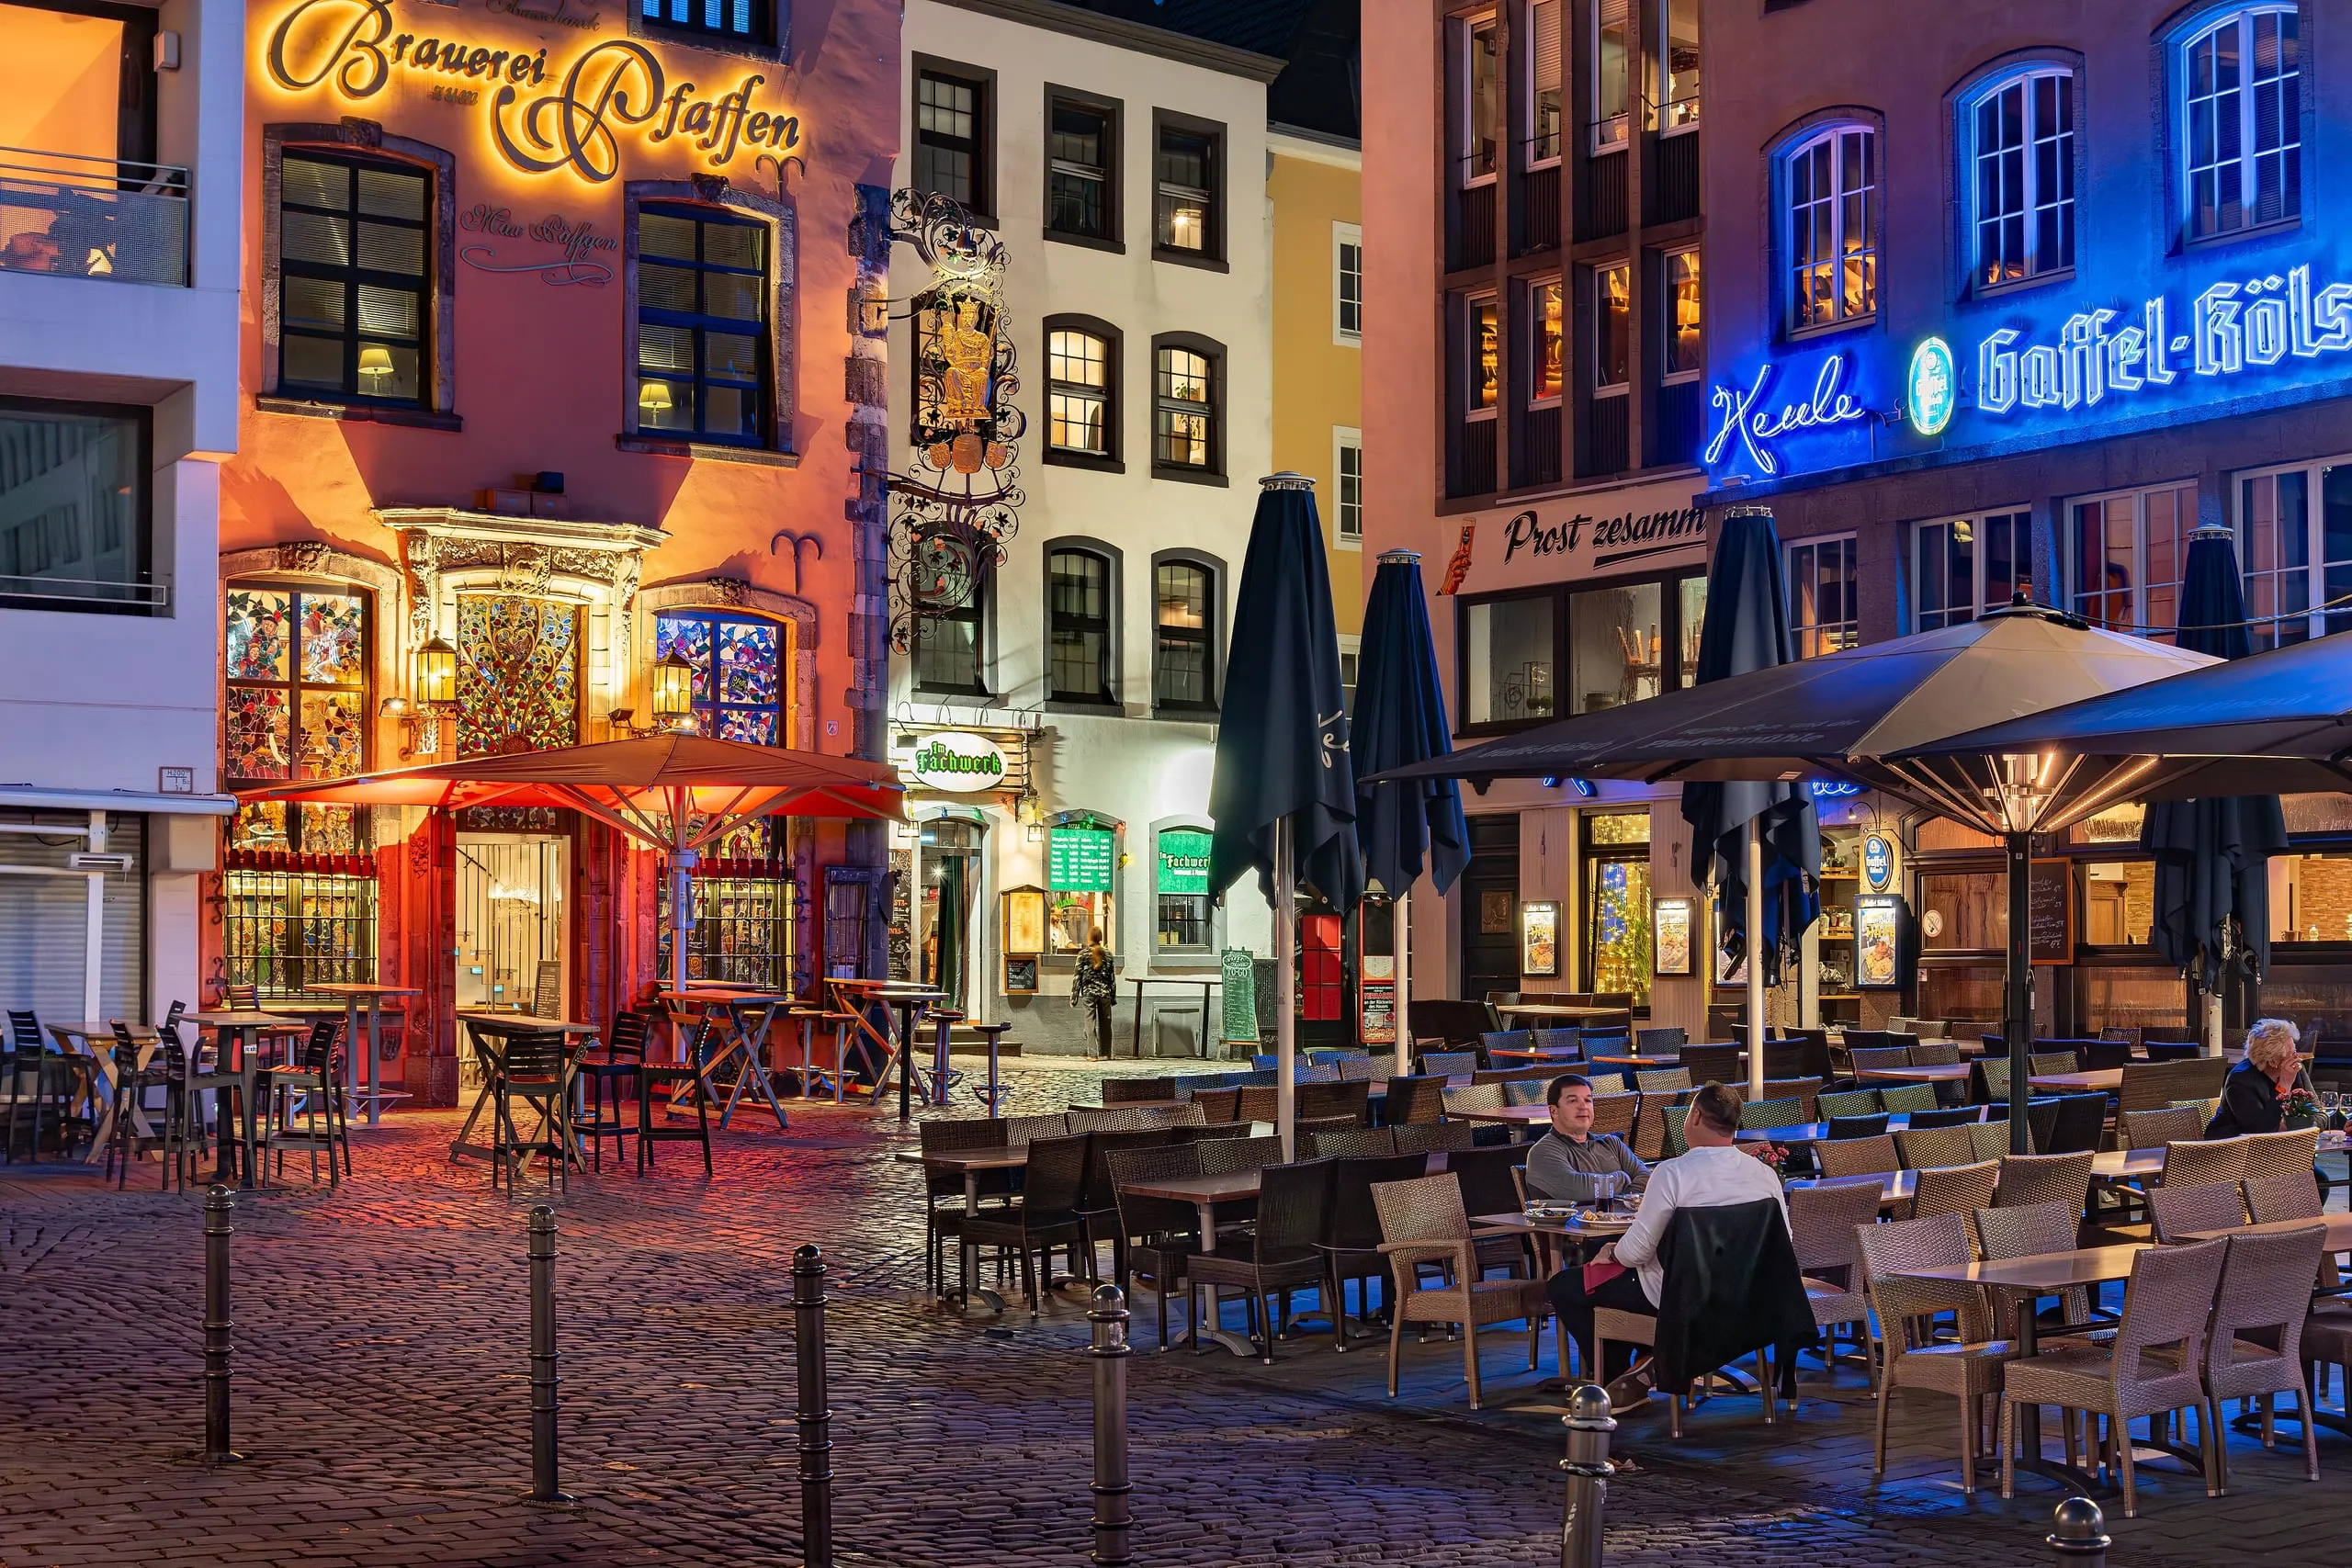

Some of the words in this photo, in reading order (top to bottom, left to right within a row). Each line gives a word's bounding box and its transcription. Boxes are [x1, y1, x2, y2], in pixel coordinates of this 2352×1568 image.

[267, 0, 546, 98] Brauerei
[431, 85, 479, 106] zum
[491, 38, 799, 183] Pfaffen
[1705, 355, 1865, 474] Keule
[1504, 510, 1592, 565] Prost
[916, 749, 1001, 775] Fachwerk
[932, 741, 945, 754] Im
